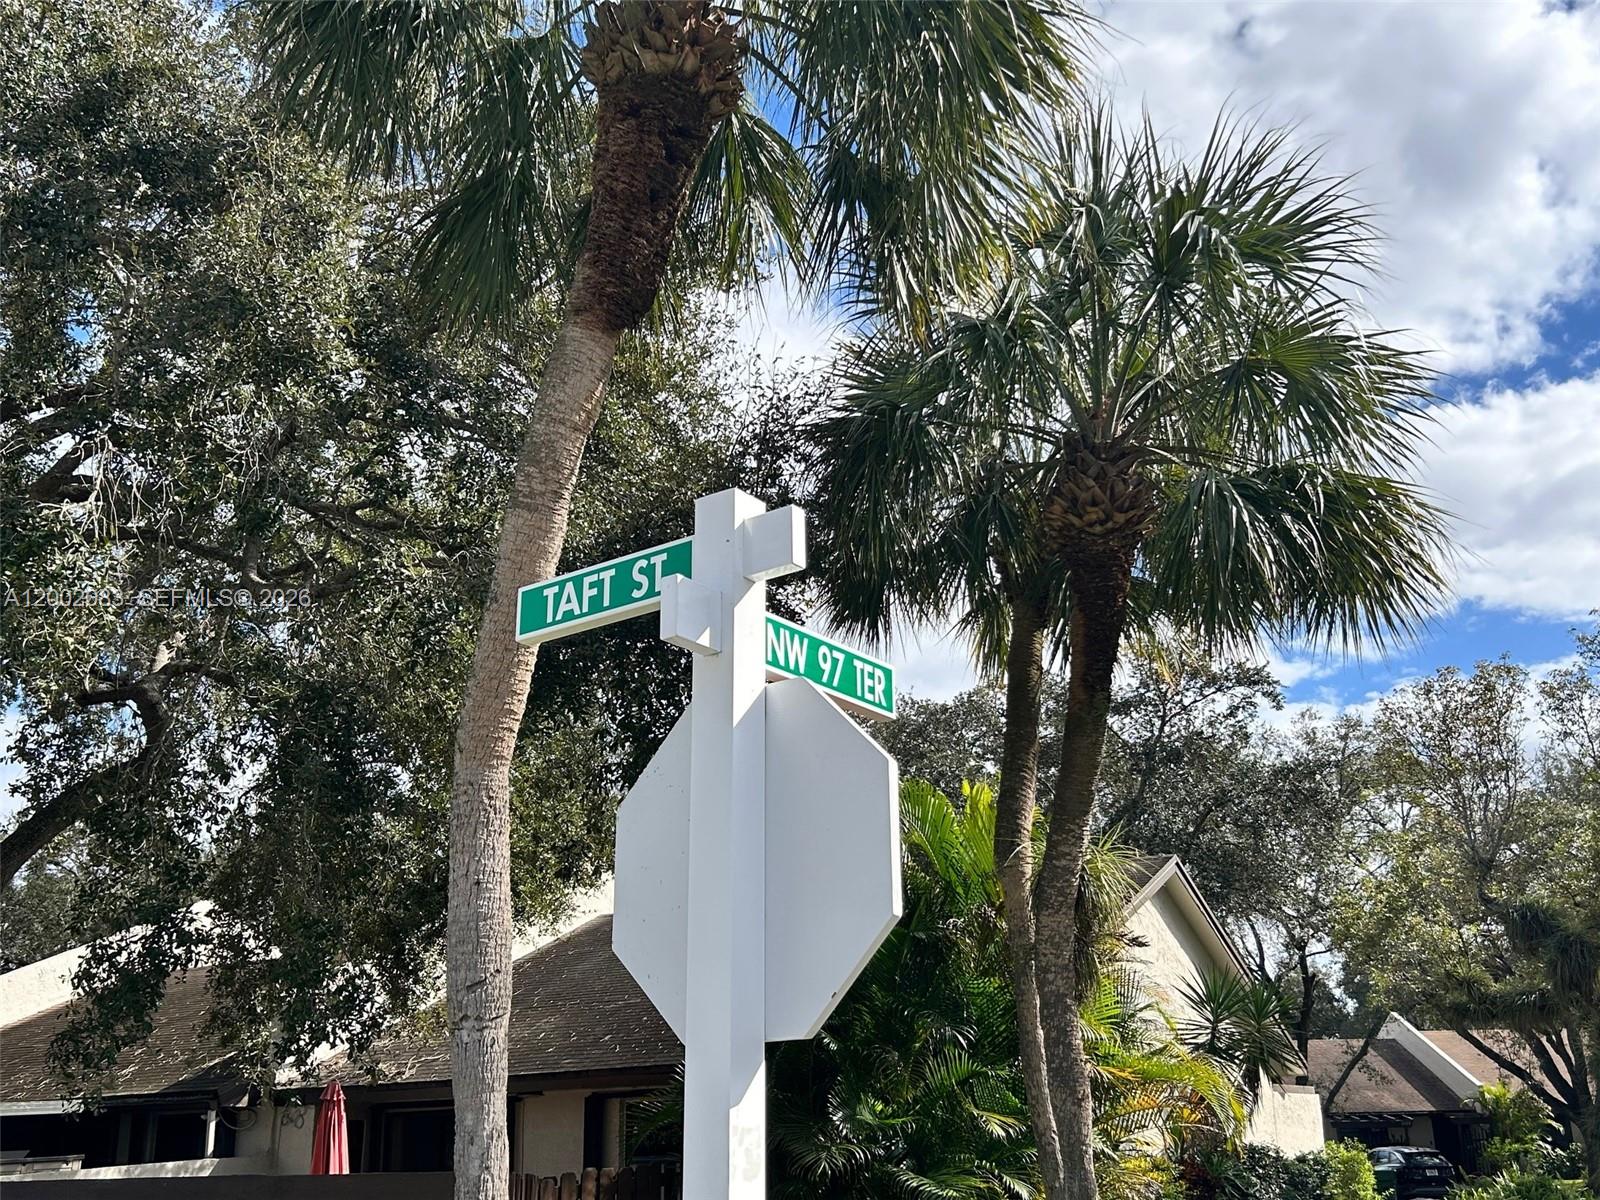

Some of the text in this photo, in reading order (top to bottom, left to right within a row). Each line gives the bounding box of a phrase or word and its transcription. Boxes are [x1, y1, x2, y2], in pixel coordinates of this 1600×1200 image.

[543, 552, 667, 624] TAFT ST
[767, 621, 887, 708] NW 97 TER
